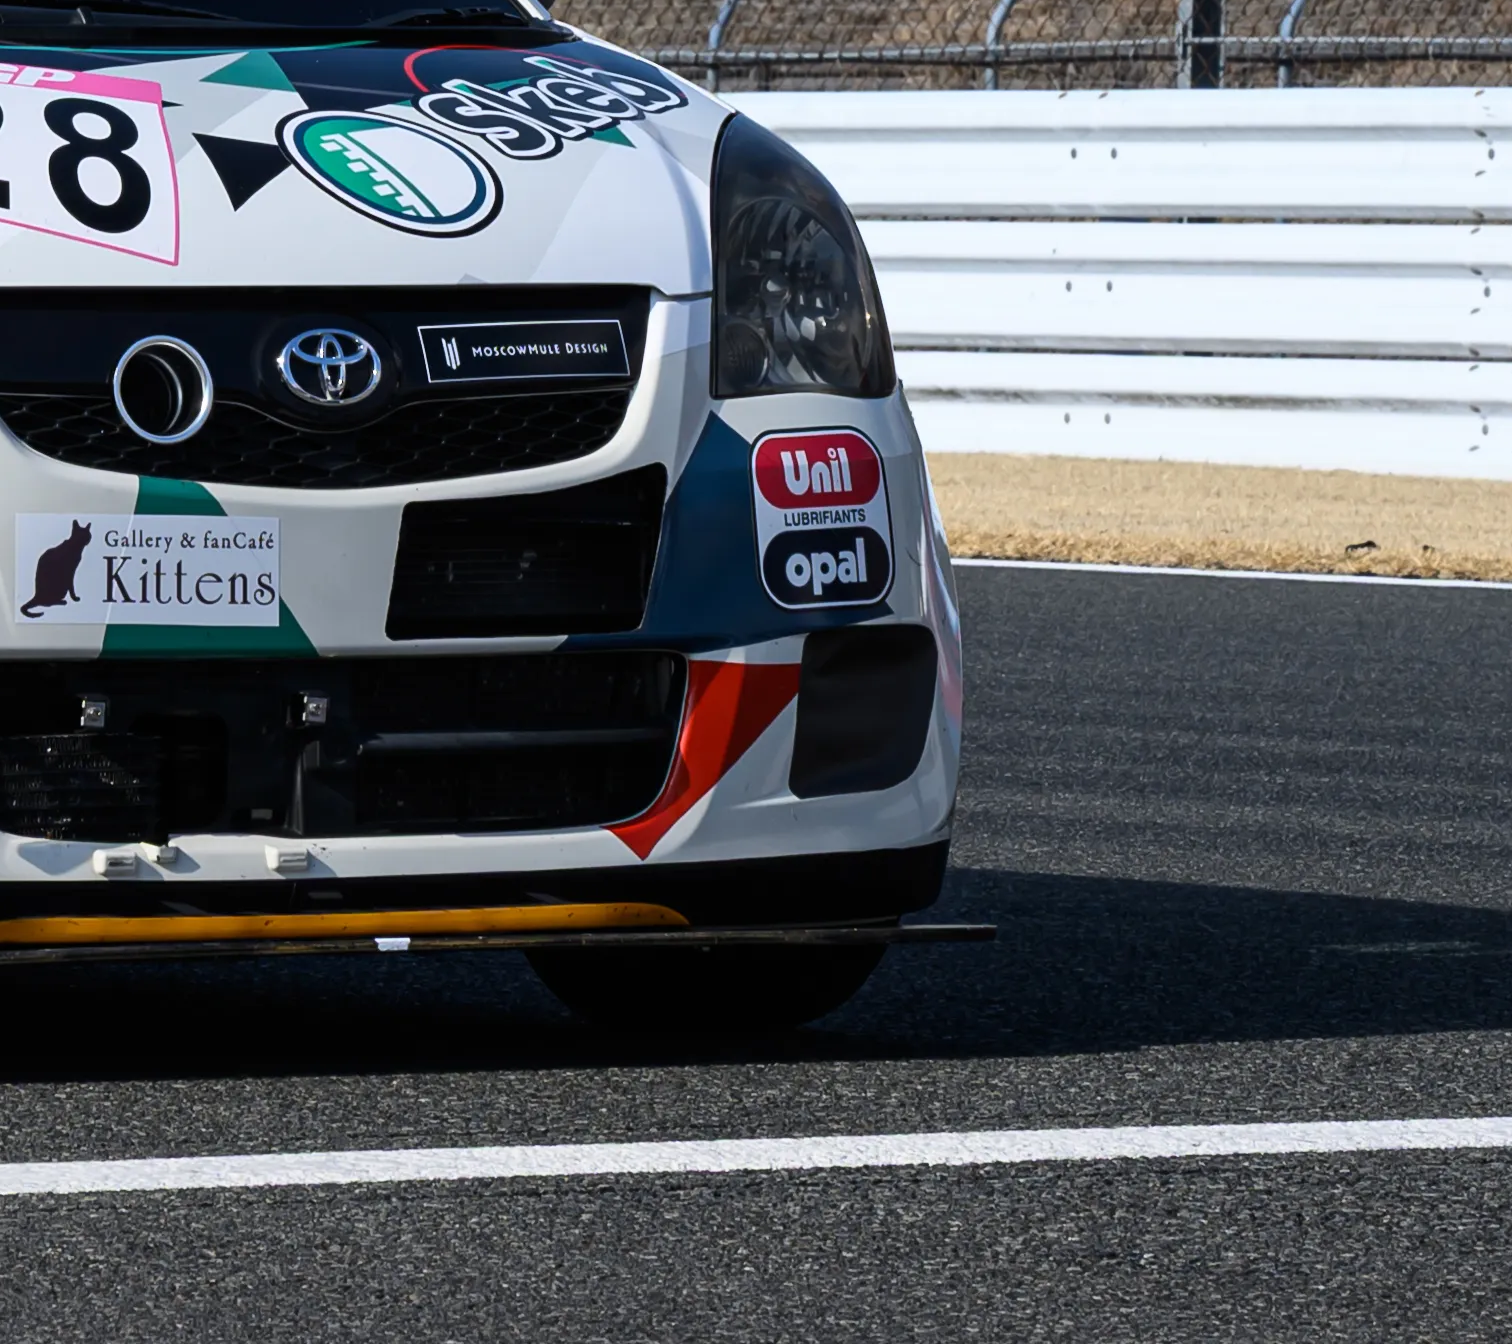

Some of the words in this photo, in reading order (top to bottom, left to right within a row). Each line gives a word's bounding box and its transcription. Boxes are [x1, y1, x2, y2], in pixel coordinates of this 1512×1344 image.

[418, 56, 681, 157] Skeb
[780, 447, 853, 496] Unil
[104, 529, 173, 553] Gallery
[180, 532, 196, 548] &
[203, 530, 275, 550] fanCafé
[784, 508, 866, 527] LUBRIFIANTS
[102, 556, 276, 606] Kittens
[785, 537, 868, 596] opal
